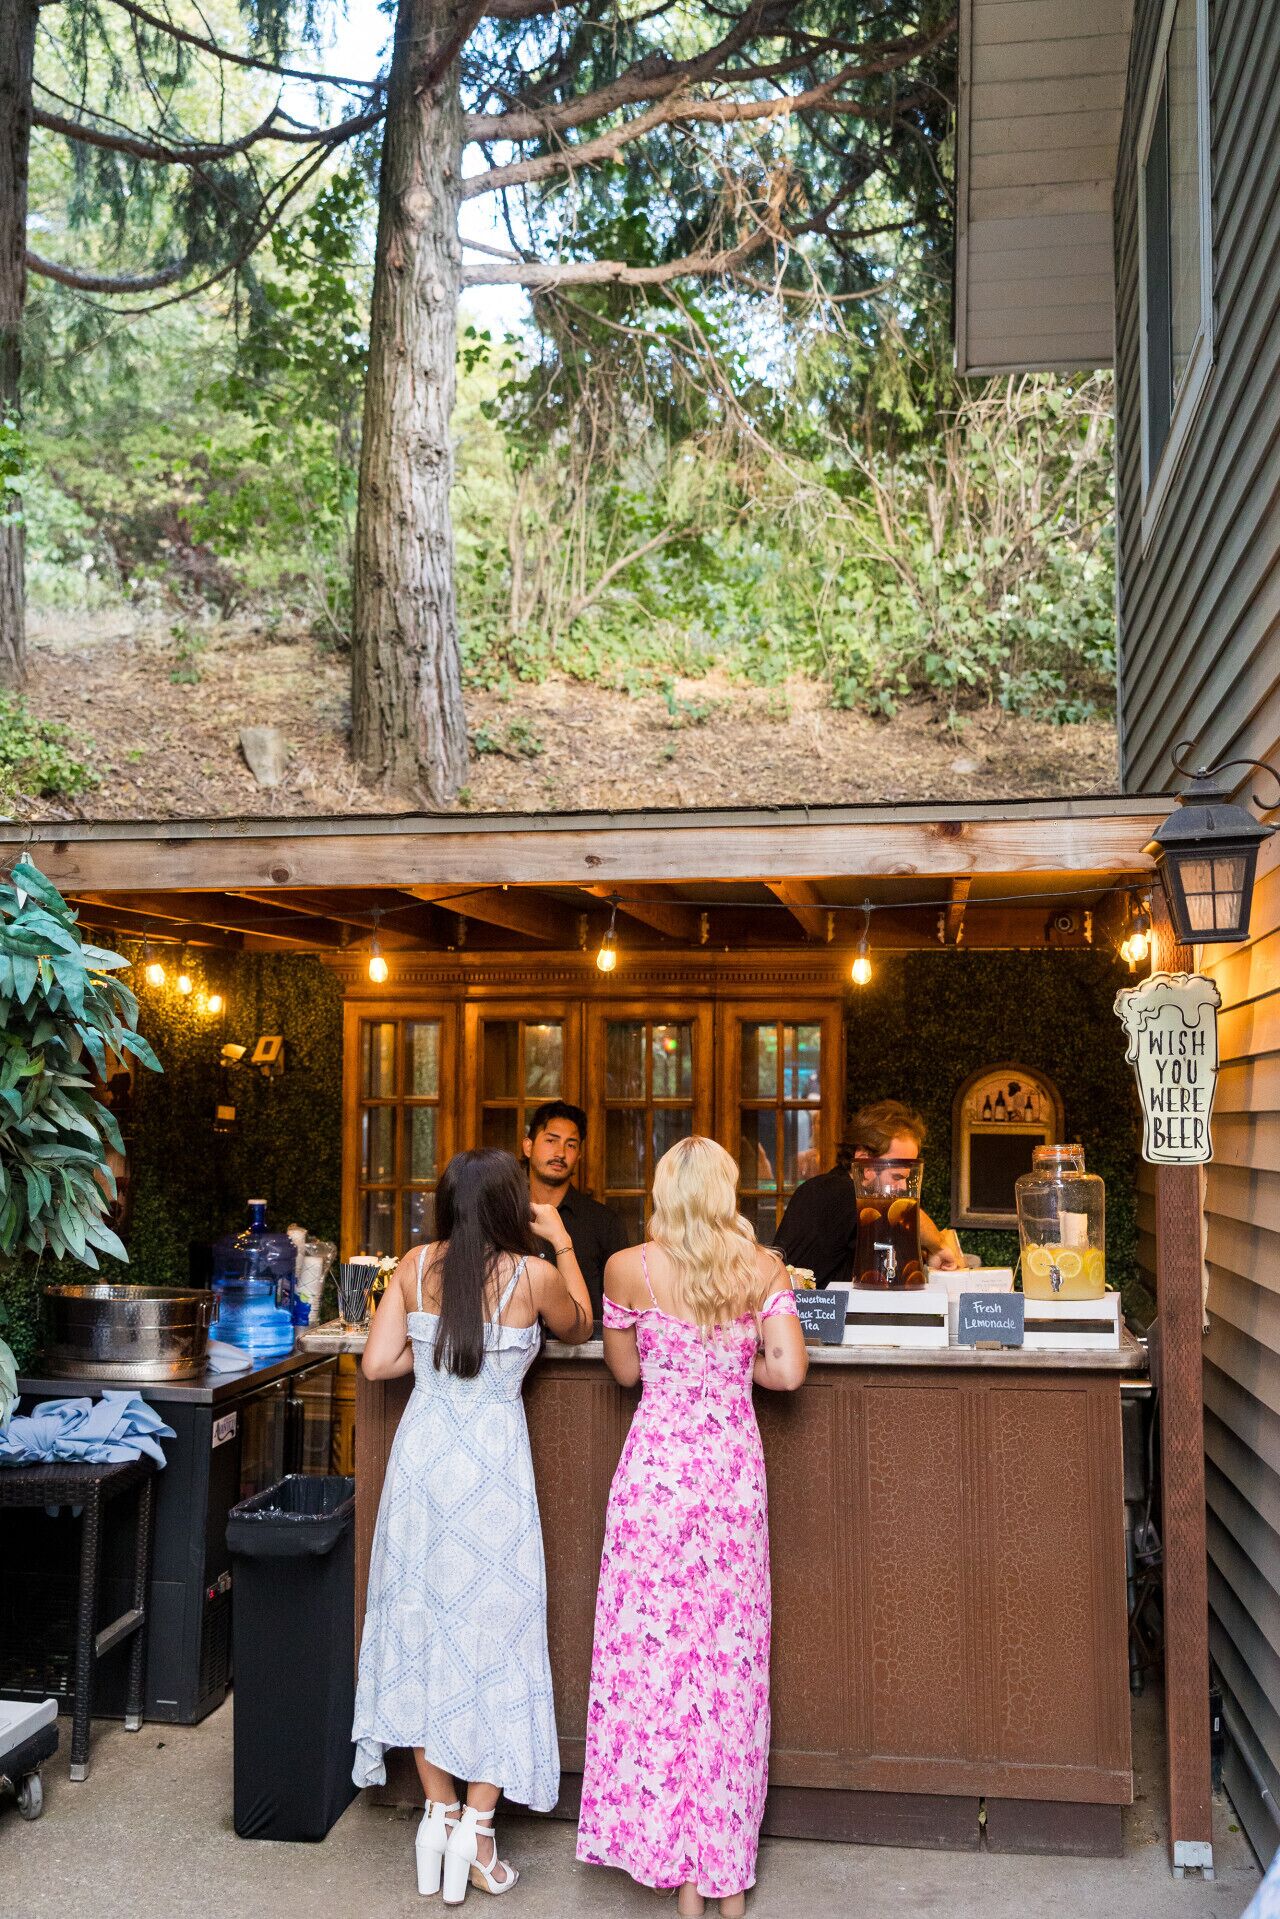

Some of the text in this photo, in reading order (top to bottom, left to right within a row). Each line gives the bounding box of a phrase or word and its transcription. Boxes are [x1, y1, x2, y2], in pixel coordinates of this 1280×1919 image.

[1149, 1030, 1205, 1056] WISH
[1156, 1059, 1198, 1084] YOU
[1150, 1087, 1205, 1113] WERE
[1153, 1116, 1204, 1149] BEER
[795, 1293, 836, 1305] Sweetened
[972, 1300, 1002, 1313] Fresh
[796, 1308, 836, 1319] lack Iced
[800, 1319, 820, 1331] Tea
[964, 1317, 1017, 1330] Lemonade
